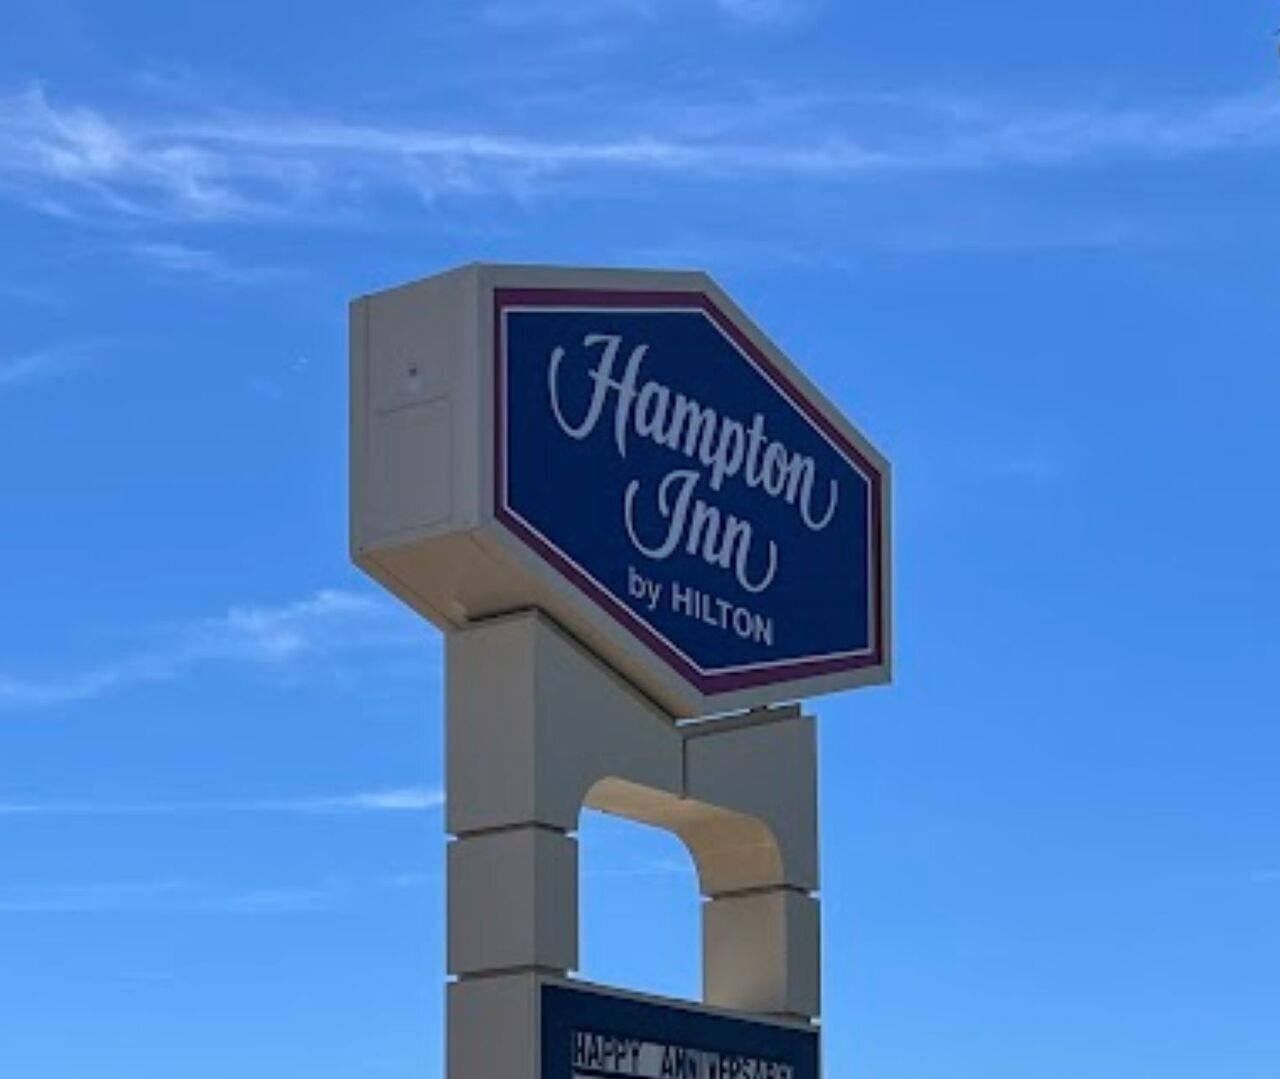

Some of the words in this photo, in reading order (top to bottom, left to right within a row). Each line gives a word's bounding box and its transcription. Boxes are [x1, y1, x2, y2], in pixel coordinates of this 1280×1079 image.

[549, 334, 838, 530] Hampton
[624, 470, 778, 592] Inn
[628, 566, 661, 610] by
[672, 582, 774, 646] HILTON
[574, 1031, 641, 1073] HAPPY
